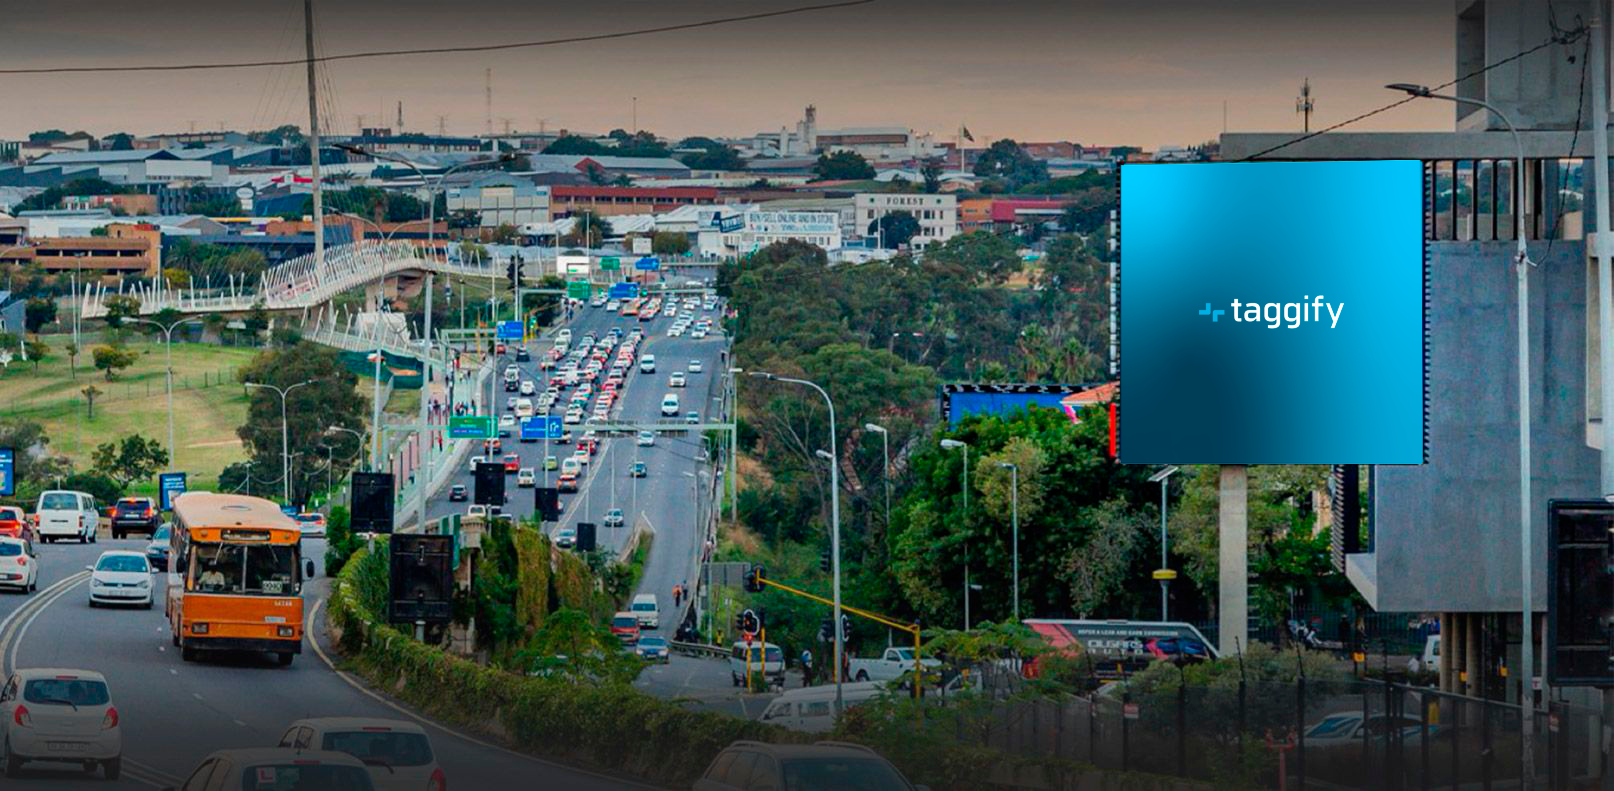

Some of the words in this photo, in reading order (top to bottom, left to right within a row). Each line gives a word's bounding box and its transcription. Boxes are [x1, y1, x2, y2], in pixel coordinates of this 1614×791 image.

[886, 197, 924, 206] FOREST
[1230, 295, 1345, 329] taggify
[260, 768, 273, 781] L
